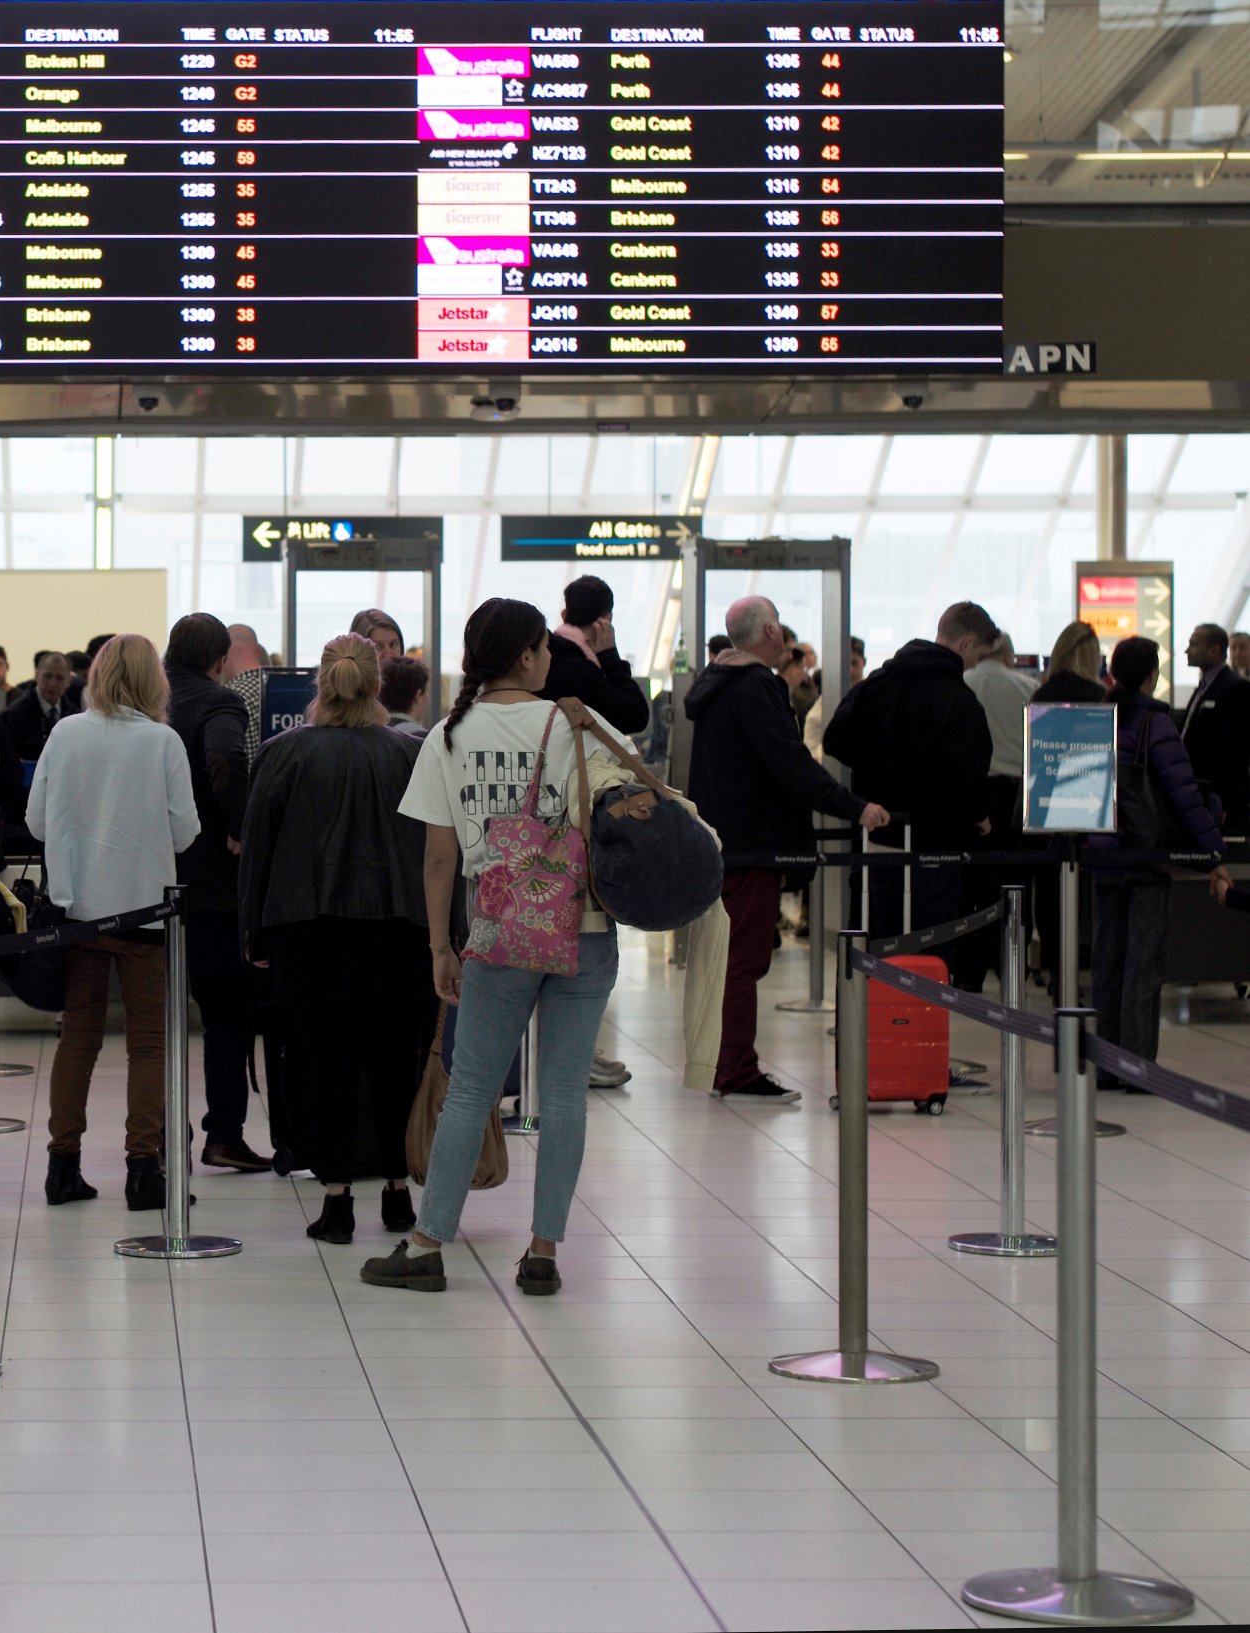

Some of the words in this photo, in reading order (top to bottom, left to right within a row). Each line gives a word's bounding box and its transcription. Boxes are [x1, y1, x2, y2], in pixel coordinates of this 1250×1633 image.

[25, 28, 119, 42] DESTINATION
[181, 28, 216, 41] TIME
[225, 28, 266, 41] GATE
[274, 29, 329, 42] STATUS
[374, 29, 414, 43] 11:55
[530, 28, 582, 41] FLIGHT
[610, 28, 704, 42] DESTINATION
[767, 27, 800, 41] TIME
[810, 27, 851, 41] GATE
[859, 28, 914, 42] STATUS
[959, 28, 999, 42] 11:55
[25, 55, 78, 68] Broken
[80, 55, 105, 68] Hill
[234, 54, 257, 68] G2
[611, 54, 650, 68] Perth
[822, 54, 841, 68] 44
[25, 87, 79, 103] Orange
[235, 86, 257, 100] G2
[611, 84, 651, 98] Perth
[26, 119, 102, 132] Melbourne
[237, 118, 256, 132] 55
[611, 117, 646, 131] Gold
[648, 117, 692, 131] Coast
[822, 116, 840, 130] 42
[25, 151, 65, 165] Coffs
[67, 151, 127, 165] Harbour
[237, 150, 256, 165] 59
[532, 146, 586, 160] NZ7123
[611, 146, 646, 160] Gold
[648, 146, 692, 160] Coast
[25, 183, 89, 197] Adelaide
[237, 183, 256, 197] 35
[611, 179, 687, 193] Melbourne
[765, 179, 799, 193] 1315
[25, 213, 89, 226] Adelaide
[611, 211, 675, 225] Brisbane
[26, 246, 102, 259] Melbourne
[181, 246, 215, 260] 1300
[237, 245, 256, 260] 45
[610, 243, 677, 257] Canberra
[821, 242, 840, 257] 33
[26, 275, 102, 289] Melbourne
[237, 275, 256, 288] 45
[610, 273, 677, 287] Canberra
[821, 272, 839, 287] 33
[26, 308, 90, 322] Brisbane
[237, 308, 255, 322] 38
[438, 308, 488, 320] Jetstar
[610, 305, 645, 320] Gold
[647, 305, 691, 320] Coast
[765, 305, 799, 320] 1340
[27, 338, 91, 351] Brisbane
[438, 340, 488, 352] Jetstar
[611, 338, 686, 352] Melbourne
[1008, 344, 1090, 373] APN
[303, 521, 330, 538] Lift
[589, 521, 612, 538] All
[614, 521, 661, 538] Gates
[1032, 739, 1067, 749] Please
[1070, 741, 1111, 752] proceed
[469, 751, 535, 781] THE
[1044, 754, 1054, 762] to
[1058, 754, 1098, 765] Security
[1045, 766, 1097, 779] Screening
